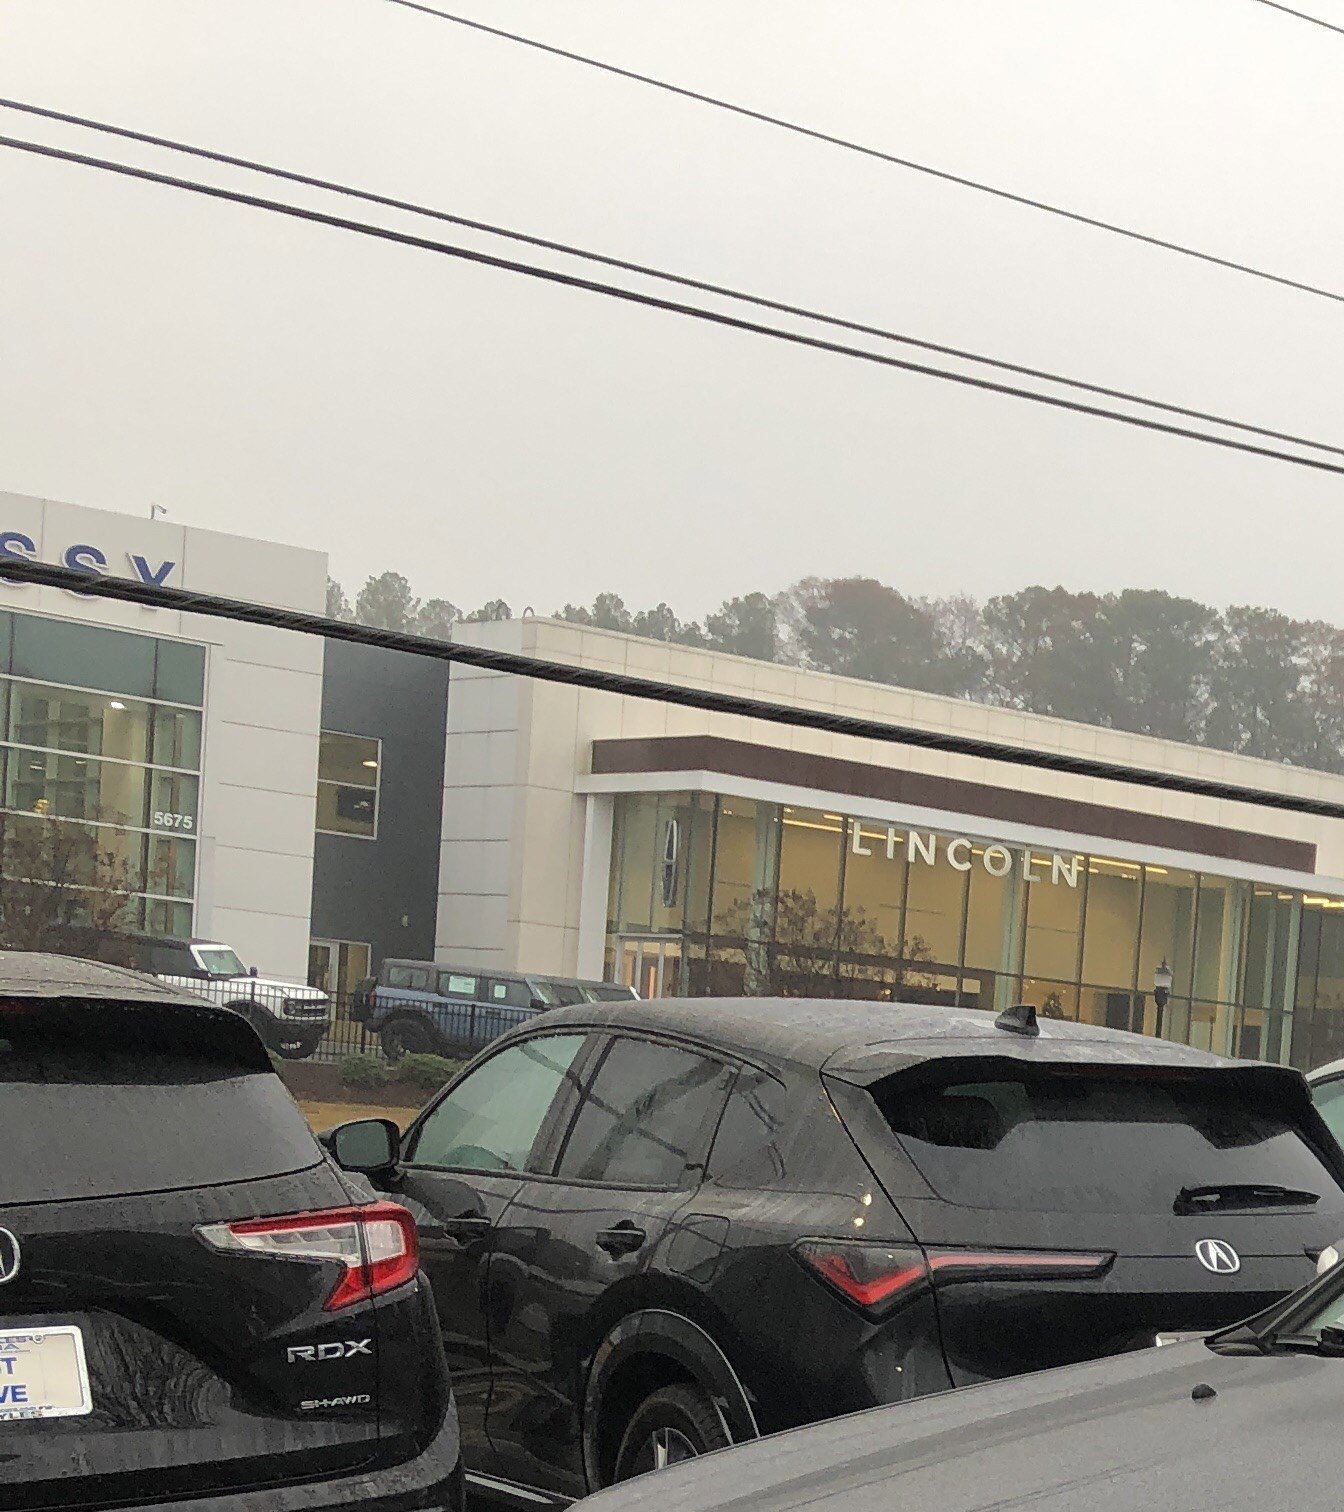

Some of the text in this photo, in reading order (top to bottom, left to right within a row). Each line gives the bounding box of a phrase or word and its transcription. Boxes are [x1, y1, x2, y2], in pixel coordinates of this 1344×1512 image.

[154, 811, 193, 830] 5675
[852, 822, 1078, 888] LINCOLN
[287, 1338, 373, 1363] RDX
